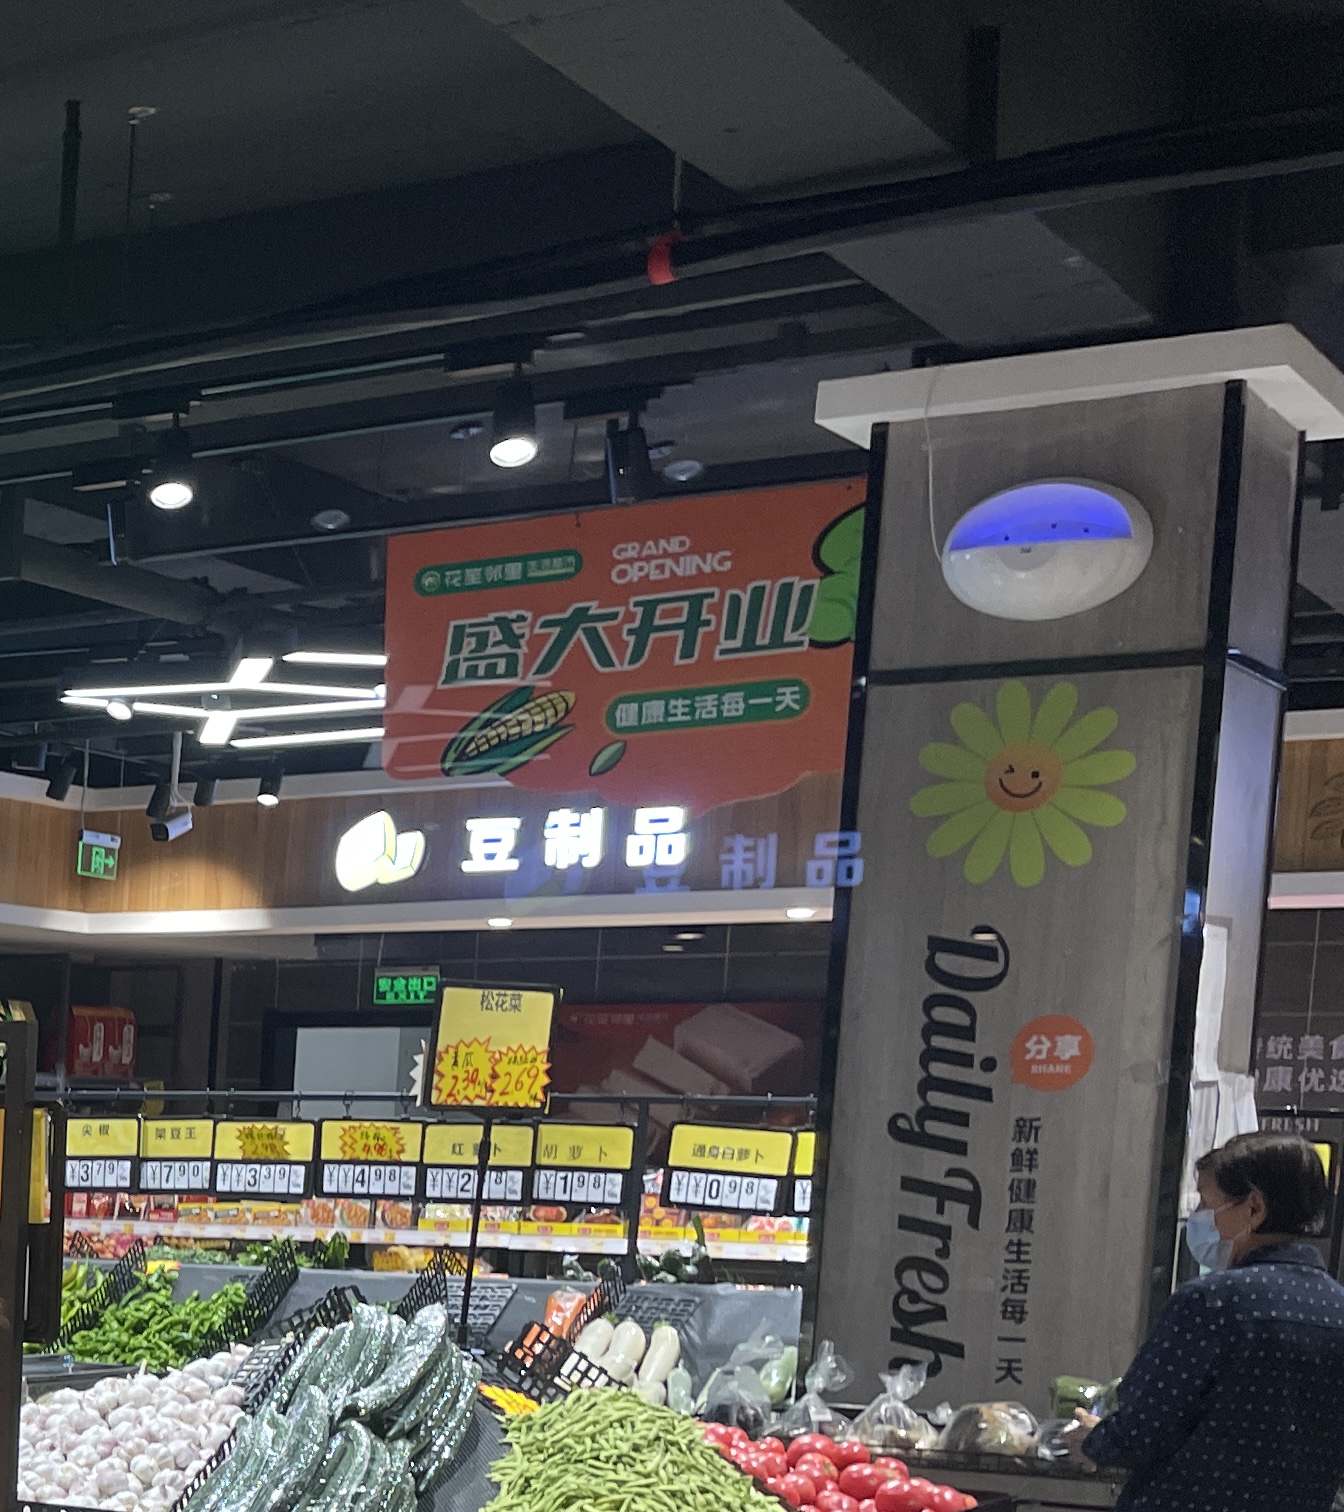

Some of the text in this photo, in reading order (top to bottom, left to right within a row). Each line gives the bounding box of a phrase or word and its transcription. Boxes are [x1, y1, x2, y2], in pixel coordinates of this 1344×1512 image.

[610, 550, 733, 585] OPENING
[611, 536, 691, 560] GRAND
[436, 576, 820, 690] 盛大开业
[614, 686, 803, 730] 健康生活每一天
[459, 804, 690, 875] 豆制品
[1023, 1033, 1083, 1062] 分享
[887, 922, 1011, 1379] Daily Fresh
[993, 1115, 1043, 1387] 新鲜健康生活每一天
